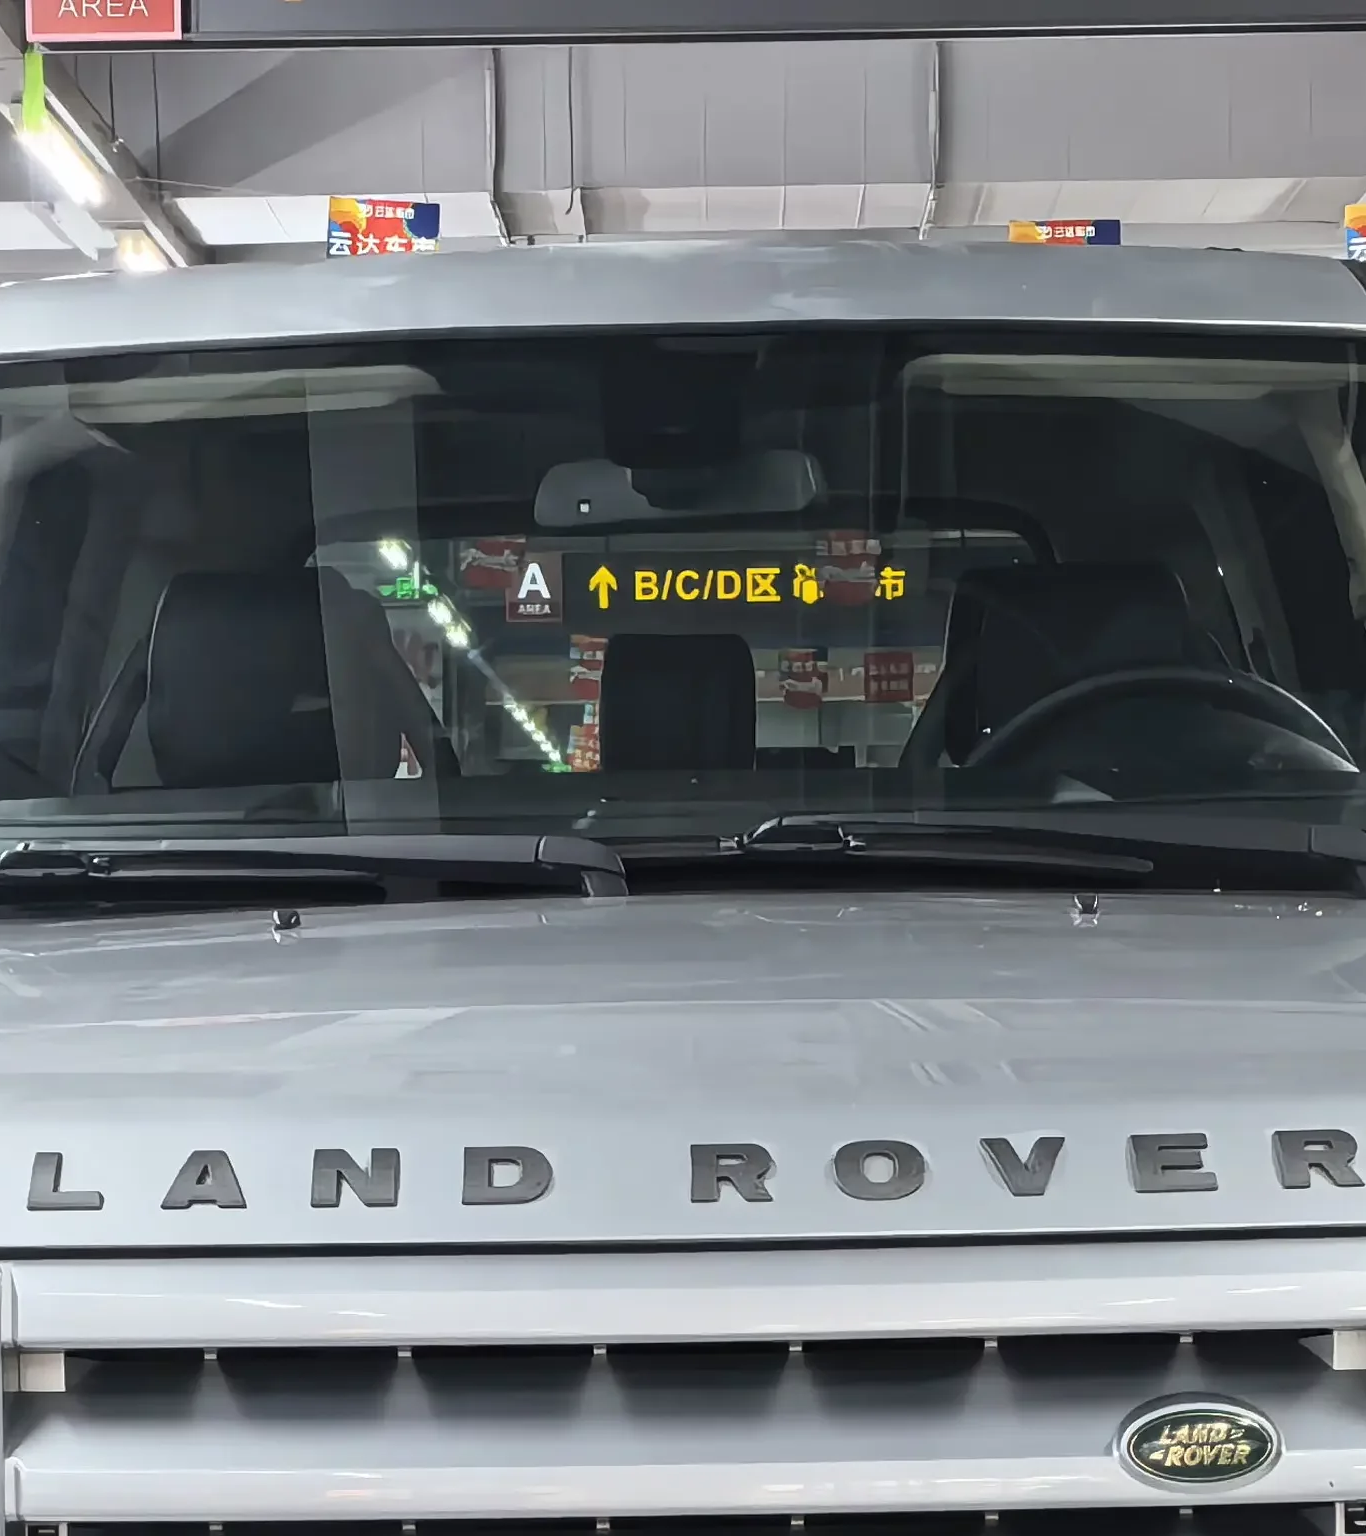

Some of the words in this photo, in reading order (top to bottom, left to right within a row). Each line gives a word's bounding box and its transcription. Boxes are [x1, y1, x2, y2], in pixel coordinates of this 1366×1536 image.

[517, 562, 552, 600] A
[634, 566, 782, 603] B/C/D区
[27, 1145, 556, 1212] LAND
[689, 1128, 1366, 1203] ROVER
[1158, 1421, 1232, 1446] LAND
[1164, 1443, 1252, 1467] ROVER
